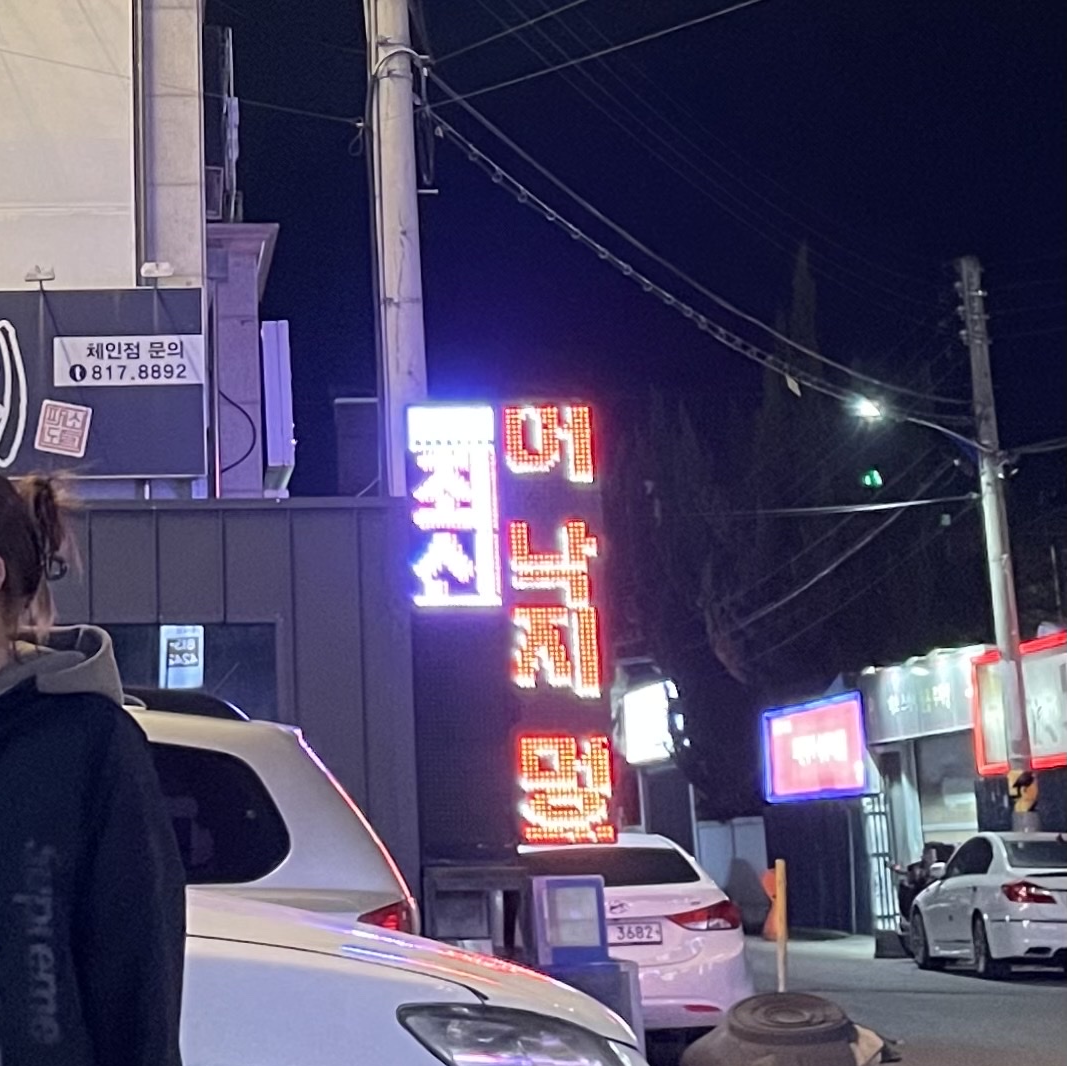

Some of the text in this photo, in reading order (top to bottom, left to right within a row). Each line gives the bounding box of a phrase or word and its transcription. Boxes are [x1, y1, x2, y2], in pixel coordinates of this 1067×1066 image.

[86, 340, 184, 360] 체인점 문의
[91, 363, 187, 381] 817.8892
[616, 925, 653, 941] 3682
